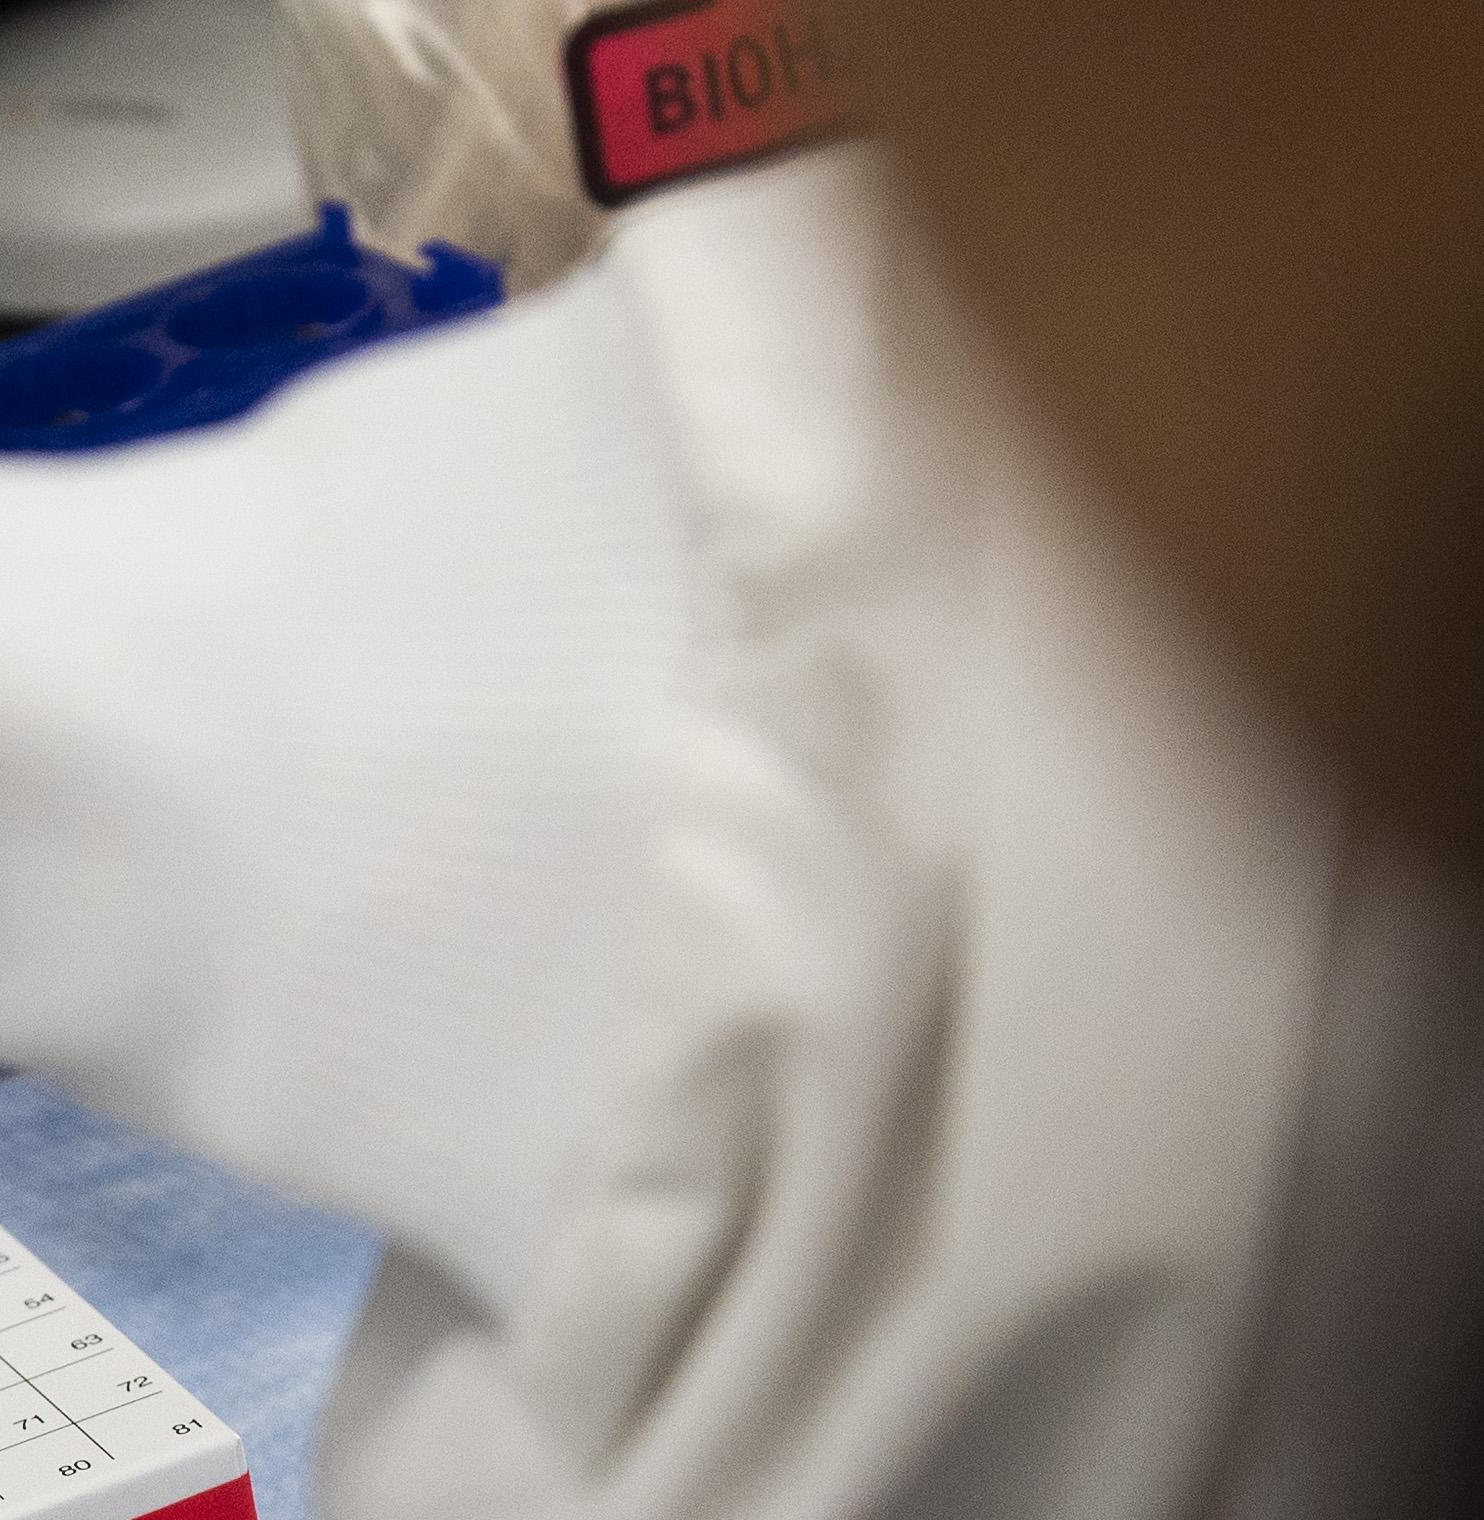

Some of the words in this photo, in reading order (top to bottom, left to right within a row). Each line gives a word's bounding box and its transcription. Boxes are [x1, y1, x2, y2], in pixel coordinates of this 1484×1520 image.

[23, 1292, 55, 1310] 54
[69, 1333, 104, 1351] 63
[13, 1414, 45, 1431] 71
[117, 1375, 152, 1393] 72
[58, 1459, 92, 1477] 80
[171, 1418, 203, 1436] 81
